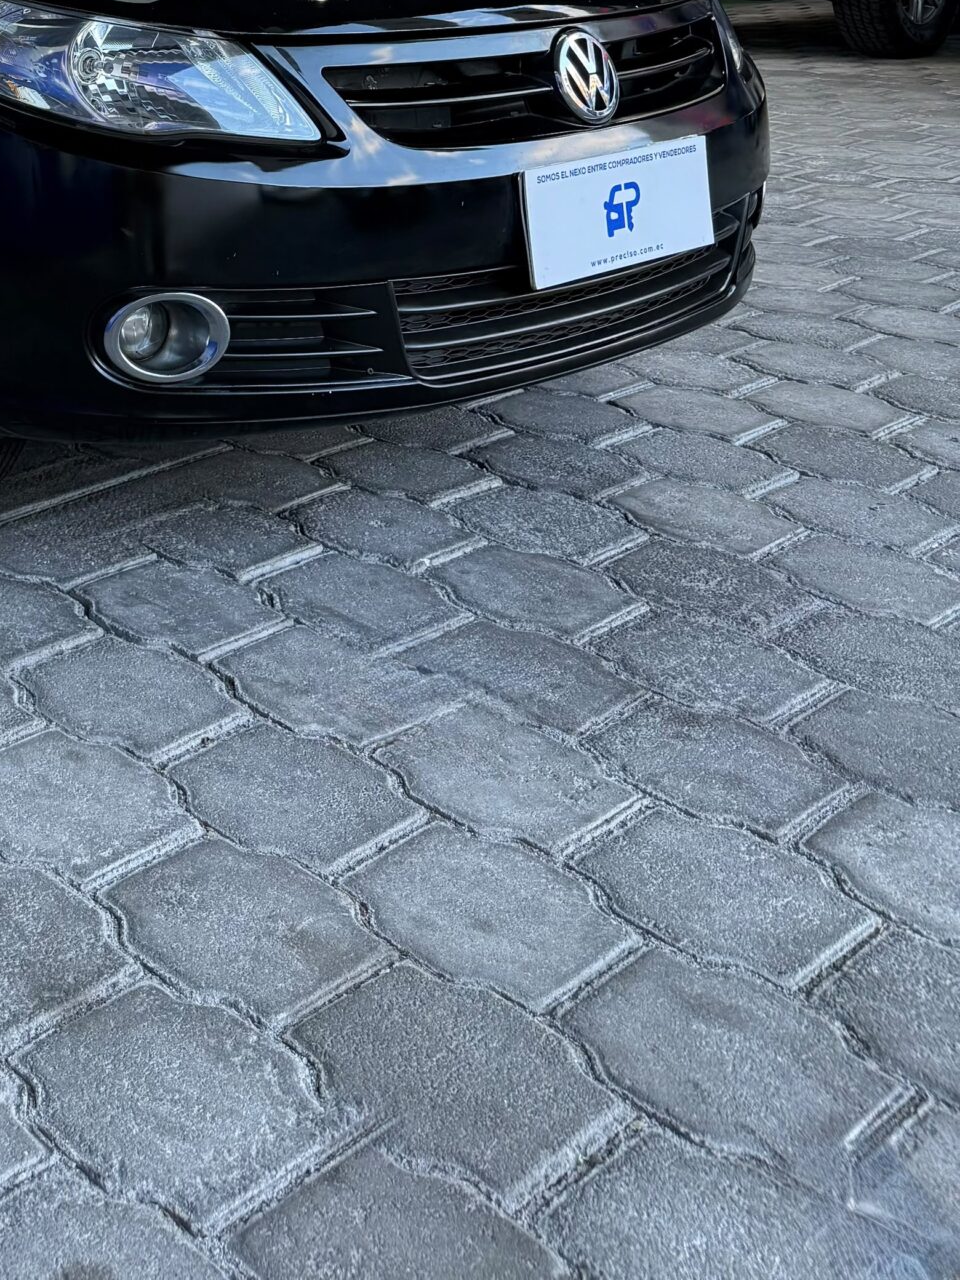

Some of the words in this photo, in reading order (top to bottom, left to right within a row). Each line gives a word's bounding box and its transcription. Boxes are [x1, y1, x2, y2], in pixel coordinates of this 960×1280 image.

[536, 172, 560, 184] SOMOS
[561, 170, 569, 179] EL
[569, 167, 587, 178] NEXO
[587, 162, 607, 174] ENTRE
[608, 154, 653, 170] COMPRADORES
[658, 145, 697, 159] VENDEDORES
[590, 243, 664, 267] www.preciso.com.ec
